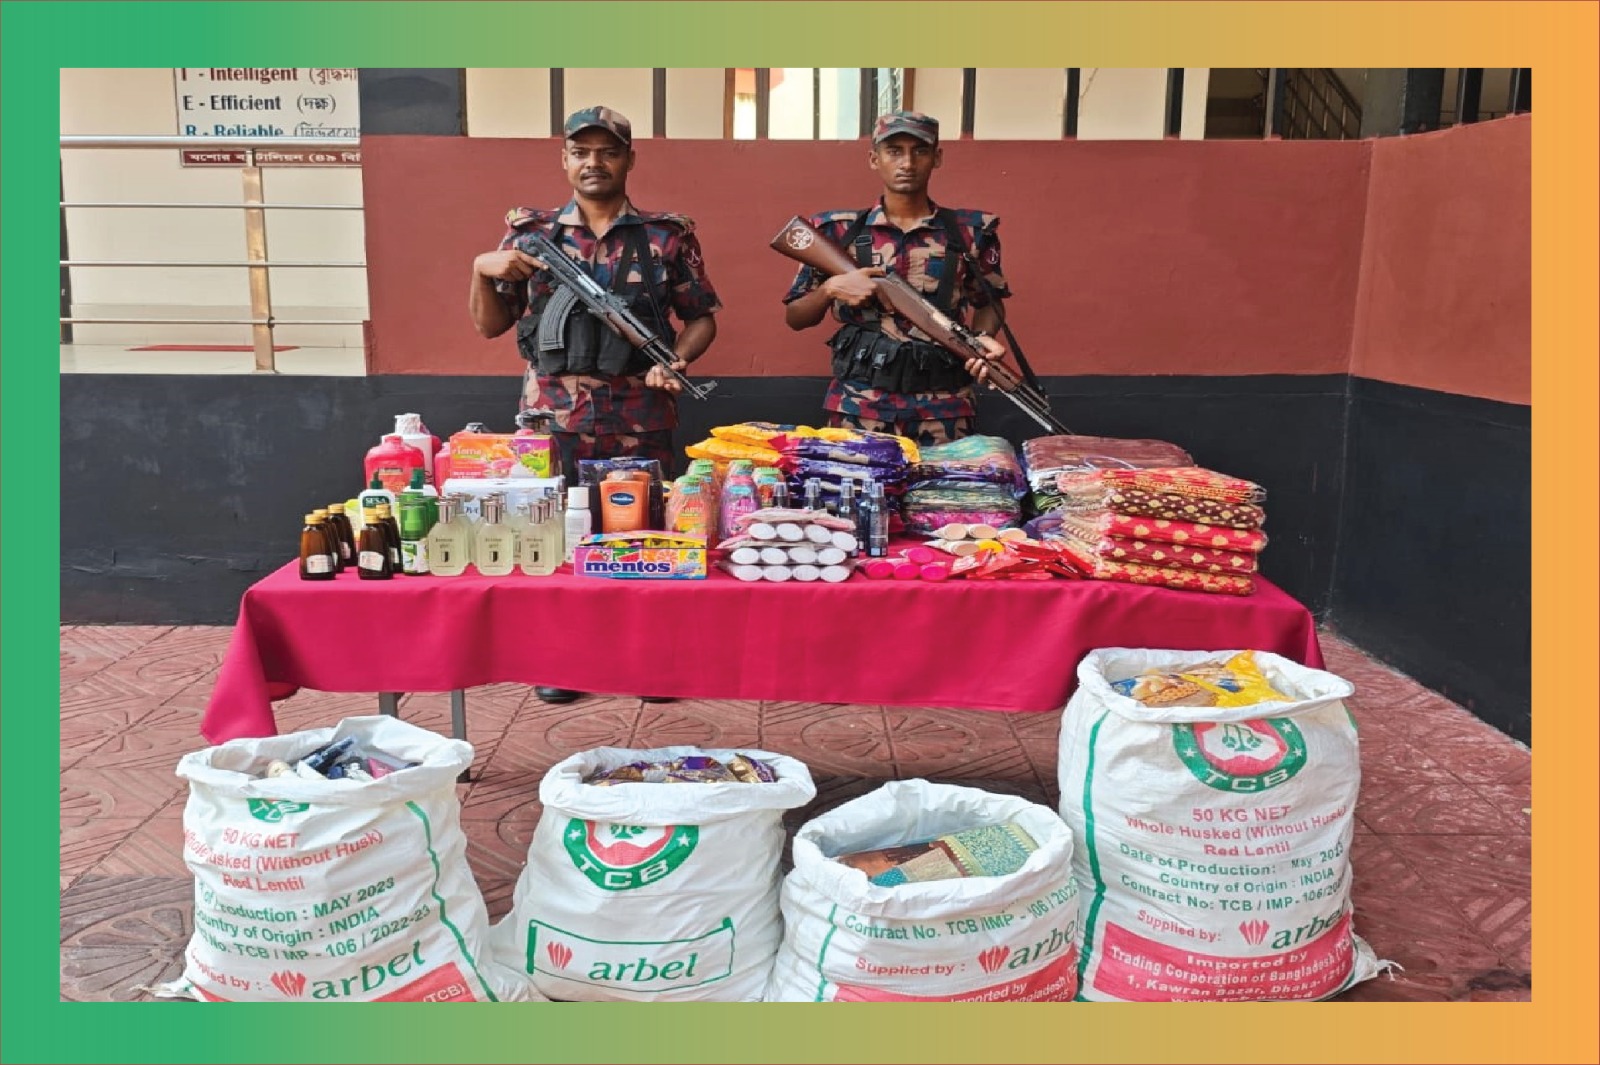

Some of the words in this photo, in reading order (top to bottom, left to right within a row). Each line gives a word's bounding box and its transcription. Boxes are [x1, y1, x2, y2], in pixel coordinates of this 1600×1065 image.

[210, 68, 298, 84] Intelligent
[182, 95, 194, 110] E
[210, 95, 282, 110] Efficient
[296, 94, 336, 114] (দক্ষ)
[214, 124, 283, 136] Reliable
[585, 561, 671, 573] mentos
[1203, 768, 1290, 791] TCB
[1192, 808, 1213, 822] 50
[1220, 807, 1248, 822] KG
[1254, 805, 1291, 821] NET
[222, 827, 239, 844] 50
[240, 832, 262, 847] KG
[264, 832, 299, 849] NET
[1124, 814, 1174, 834] Whole
[1178, 826, 1241, 839] Husked
[1246, 821, 1309, 841] (Without
[206, 852, 251, 869] usked
[256, 848, 332, 874] (Without
[336, 828, 383, 857] Husk)
[1120, 843, 1153, 862] Date
[1158, 858, 1173, 867] of
[1177, 859, 1276, 876] Production:
[1291, 858, 1312, 869] May
[1203, 844, 1239, 856] Red
[1244, 841, 1290, 856] Lentil
[222, 872, 253, 890] Red
[256, 876, 305, 891] Lentil
[578, 853, 670, 888] TCB
[1159, 873, 1219, 893] Country
[1224, 882, 1239, 892] of
[1243, 880, 1287, 894] Origin
[1300, 867, 1334, 886] INDIA
[216, 898, 297, 922] roduction
[313, 895, 352, 918] MAY
[357, 877, 395, 902] 2023
[1121, 874, 1181, 904] Contract
[1218, 899, 1252, 911] TCB
[233, 943, 270, 959] TCB
[326, 938, 357, 957] 106
[370, 904, 431, 943] 2022-23
[243, 926, 257, 939] of
[261, 928, 313, 947] Origin
[329, 905, 380, 935] INDIA
[845, 914, 910, 940] Contract
[912, 925, 941, 939] No.
[945, 918, 979, 935] TCB
[1138, 909, 1195, 937] Supplied
[230, 976, 250, 990] by
[312, 939, 425, 1000] arbel
[588, 952, 699, 982] arbel
[855, 956, 930, 975] Supplied
[935, 964, 956, 976] by
[1111, 945, 1162, 976] Trading
[1166, 963, 1248, 985] Corporation
[1252, 973, 1266, 983] of
[1270, 952, 1335, 981] Bangladesh
[1187, 955, 1284, 970] Imported
[1289, 951, 1308, 963] by
[423, 983, 465, 1002] (TCB)
[951, 985, 1009, 1002] ported
[1012, 983, 1028, 995] by
[1127, 975, 1140, 989] 1,
[1146, 979, 1210, 996] Kawran
